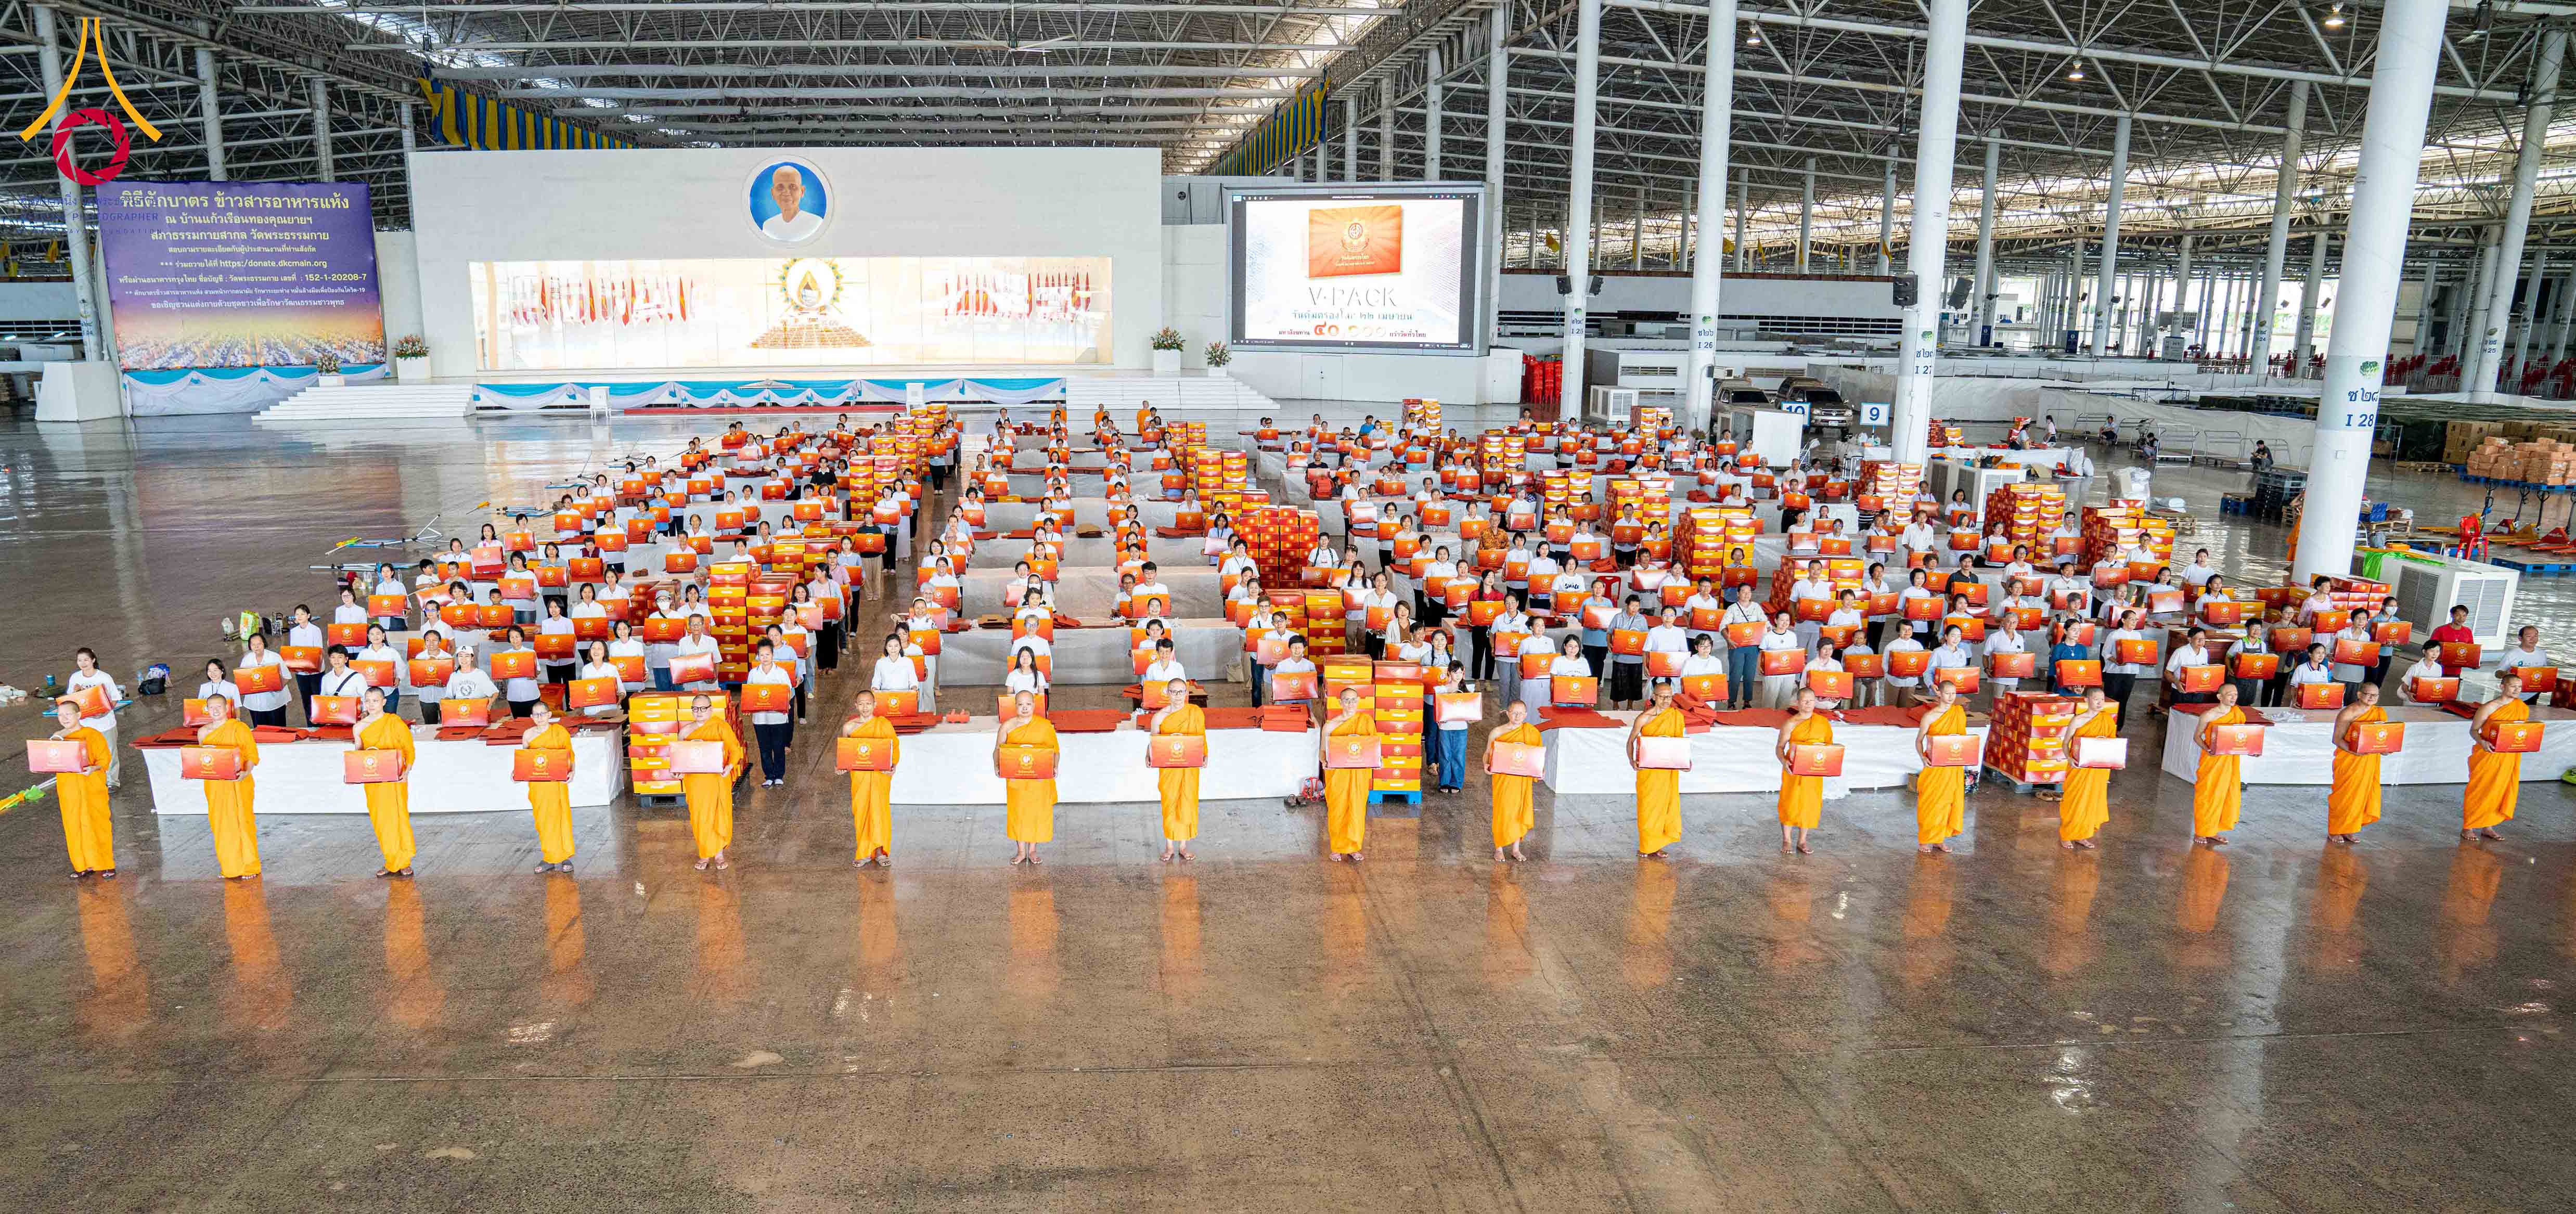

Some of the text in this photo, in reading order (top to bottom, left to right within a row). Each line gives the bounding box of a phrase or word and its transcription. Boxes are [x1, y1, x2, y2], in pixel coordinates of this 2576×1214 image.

[215, 191, 349, 208] ข้าวสารอาหารแห้ง
[181, 213, 312, 227] บ้านแก้วเรือนทองคุณยายฯ
[151, 230, 329, 240] สภาธรรมกายสากล วัดพระธรรมกาย
[229, 274, 279, 283] วัดพระธรรมกาย
[1869, 407, 1880, 421] 9
[2346, 414, 2374, 427] I 28
